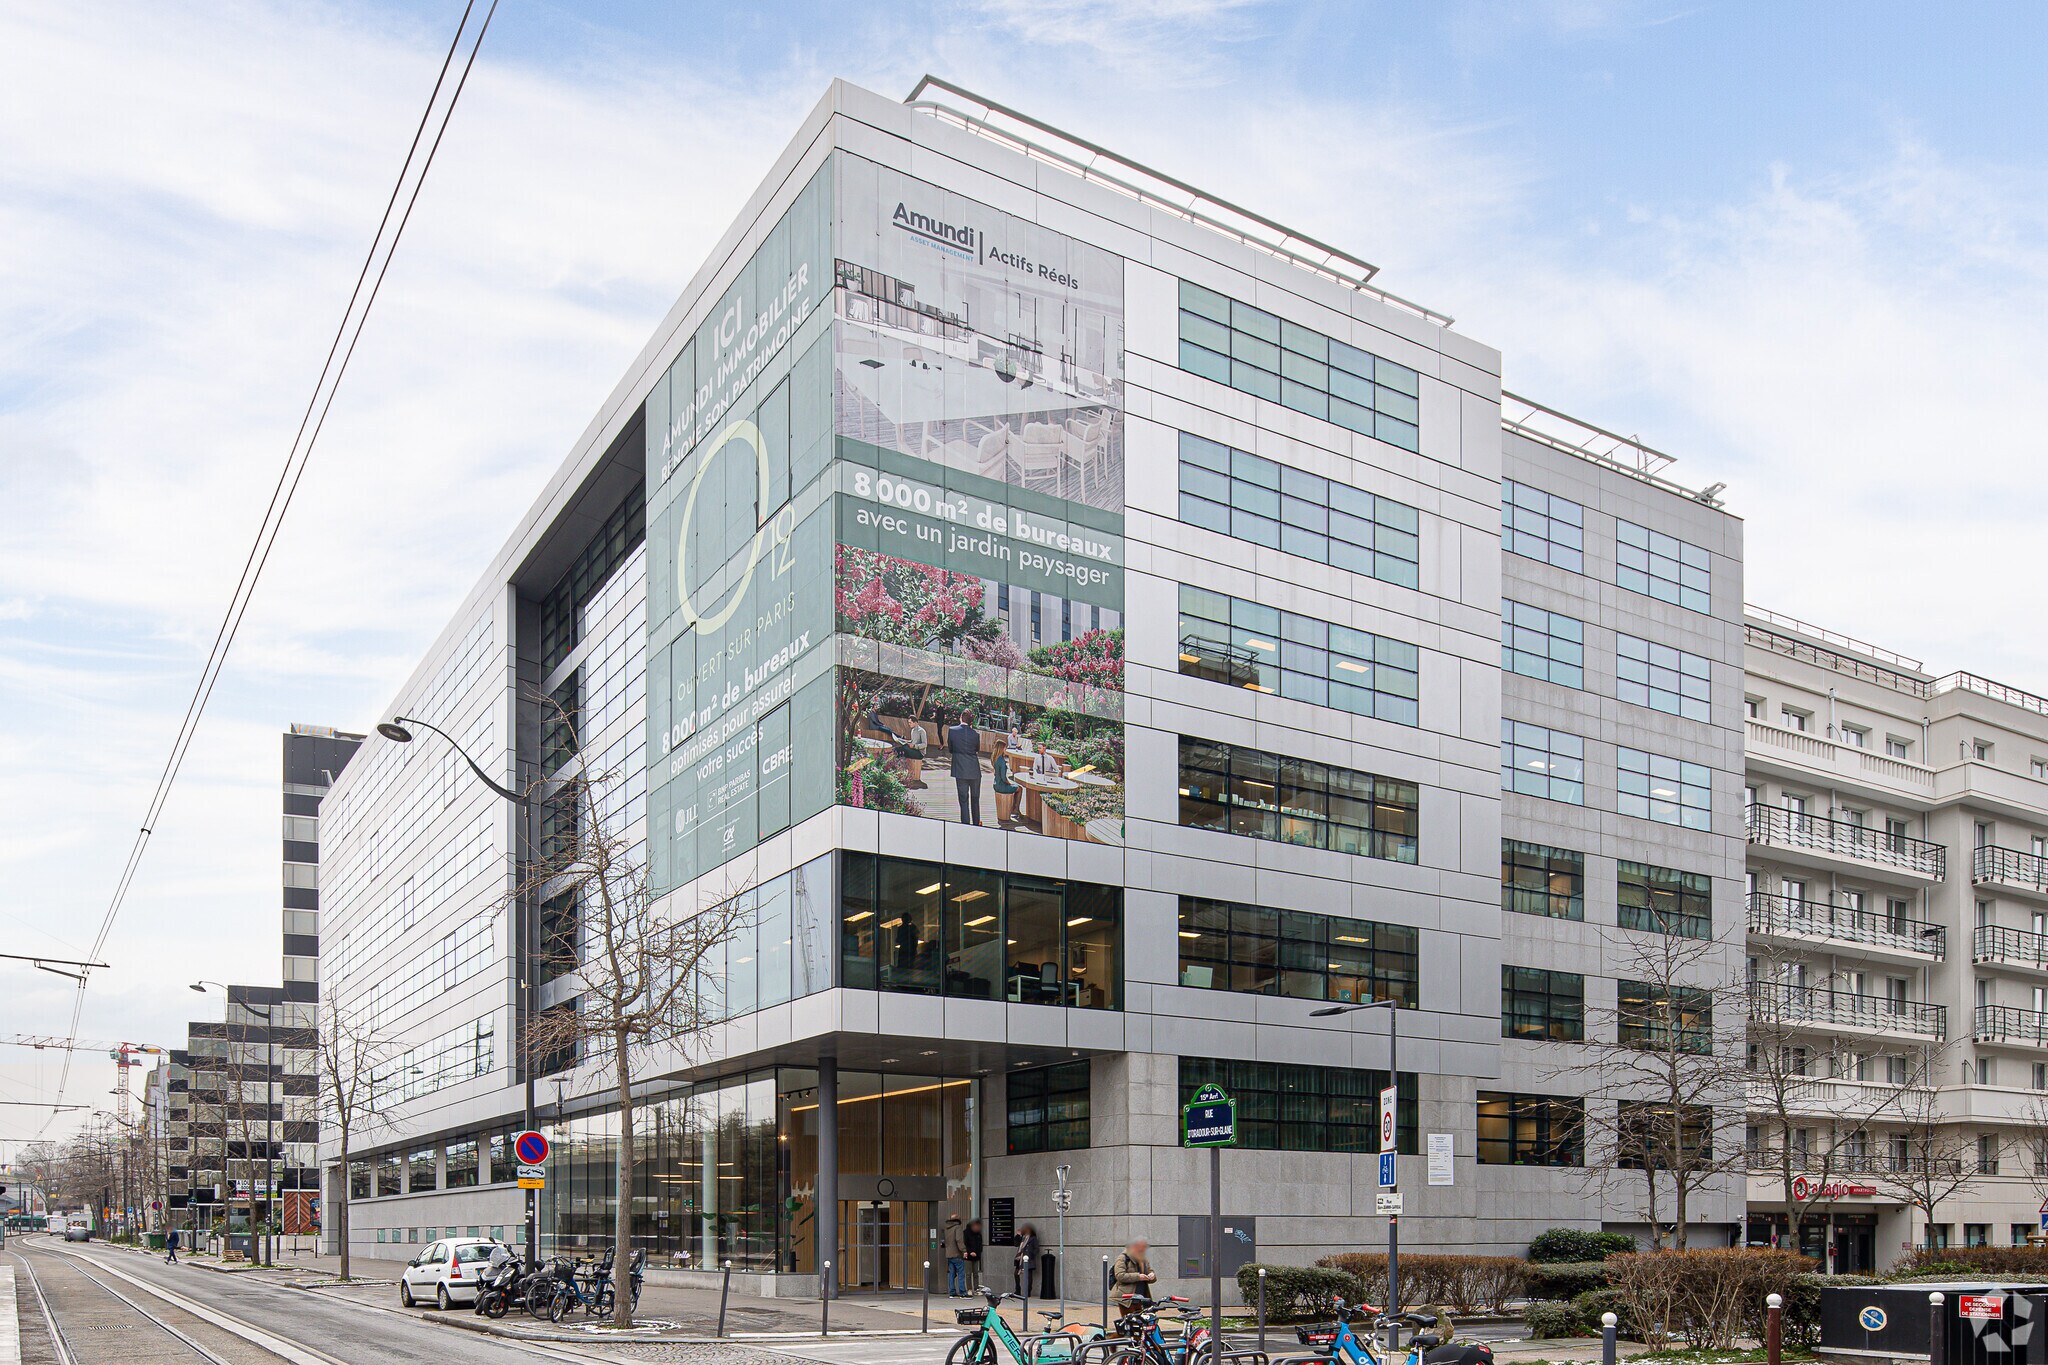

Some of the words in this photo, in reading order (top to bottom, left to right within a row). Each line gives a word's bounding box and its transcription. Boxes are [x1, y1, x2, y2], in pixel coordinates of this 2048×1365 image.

[893, 202, 974, 247] Amundi
[910, 235, 930, 249] ASSET
[930, 241, 974, 262] MANAGEMENT
[988, 246, 1033, 274] Actifs
[1038, 263, 1079, 290] Réels
[713, 296, 742, 361] ICI
[662, 377, 713, 455] AMUNDI
[717, 262, 809, 389] IMMOBILIER
[705, 392, 729, 432] SON
[732, 296, 811, 419] PATRIMOINE
[856, 508, 908, 535] avec
[916, 523, 942, 544] un
[948, 527, 1011, 562] jardin
[1019, 551, 1110, 586] paysager
[976, 505, 1007, 532] de
[1015, 513, 1112, 561] bureaux
[677, 651, 722, 701] OUVERT
[728, 627, 751, 661] SUR
[757, 591, 796, 638] PARIS
[722, 681, 740, 710] de
[744, 629, 810, 692] bureaux
[671, 727, 719, 775] optimisés
[722, 708, 749, 738] pour
[752, 672, 797, 715] assurer
[697, 754, 723, 782] votre
[726, 724, 764, 764] succès
[762, 744, 794, 775] CBRE
[717, 783, 728, 796] BNP
[729, 769, 751, 789] PARIBAS
[718, 792, 730, 804] REAL
[731, 780, 749, 797] ESTATE
[1204, 1109, 1214, 1119] RUE
[1383, 1095, 1393, 1106] ZONE
[1187, 1125, 1233, 1139] D'ORADOUR-SUR-GLANE
[1003, 1331, 1021, 1357] TIER
